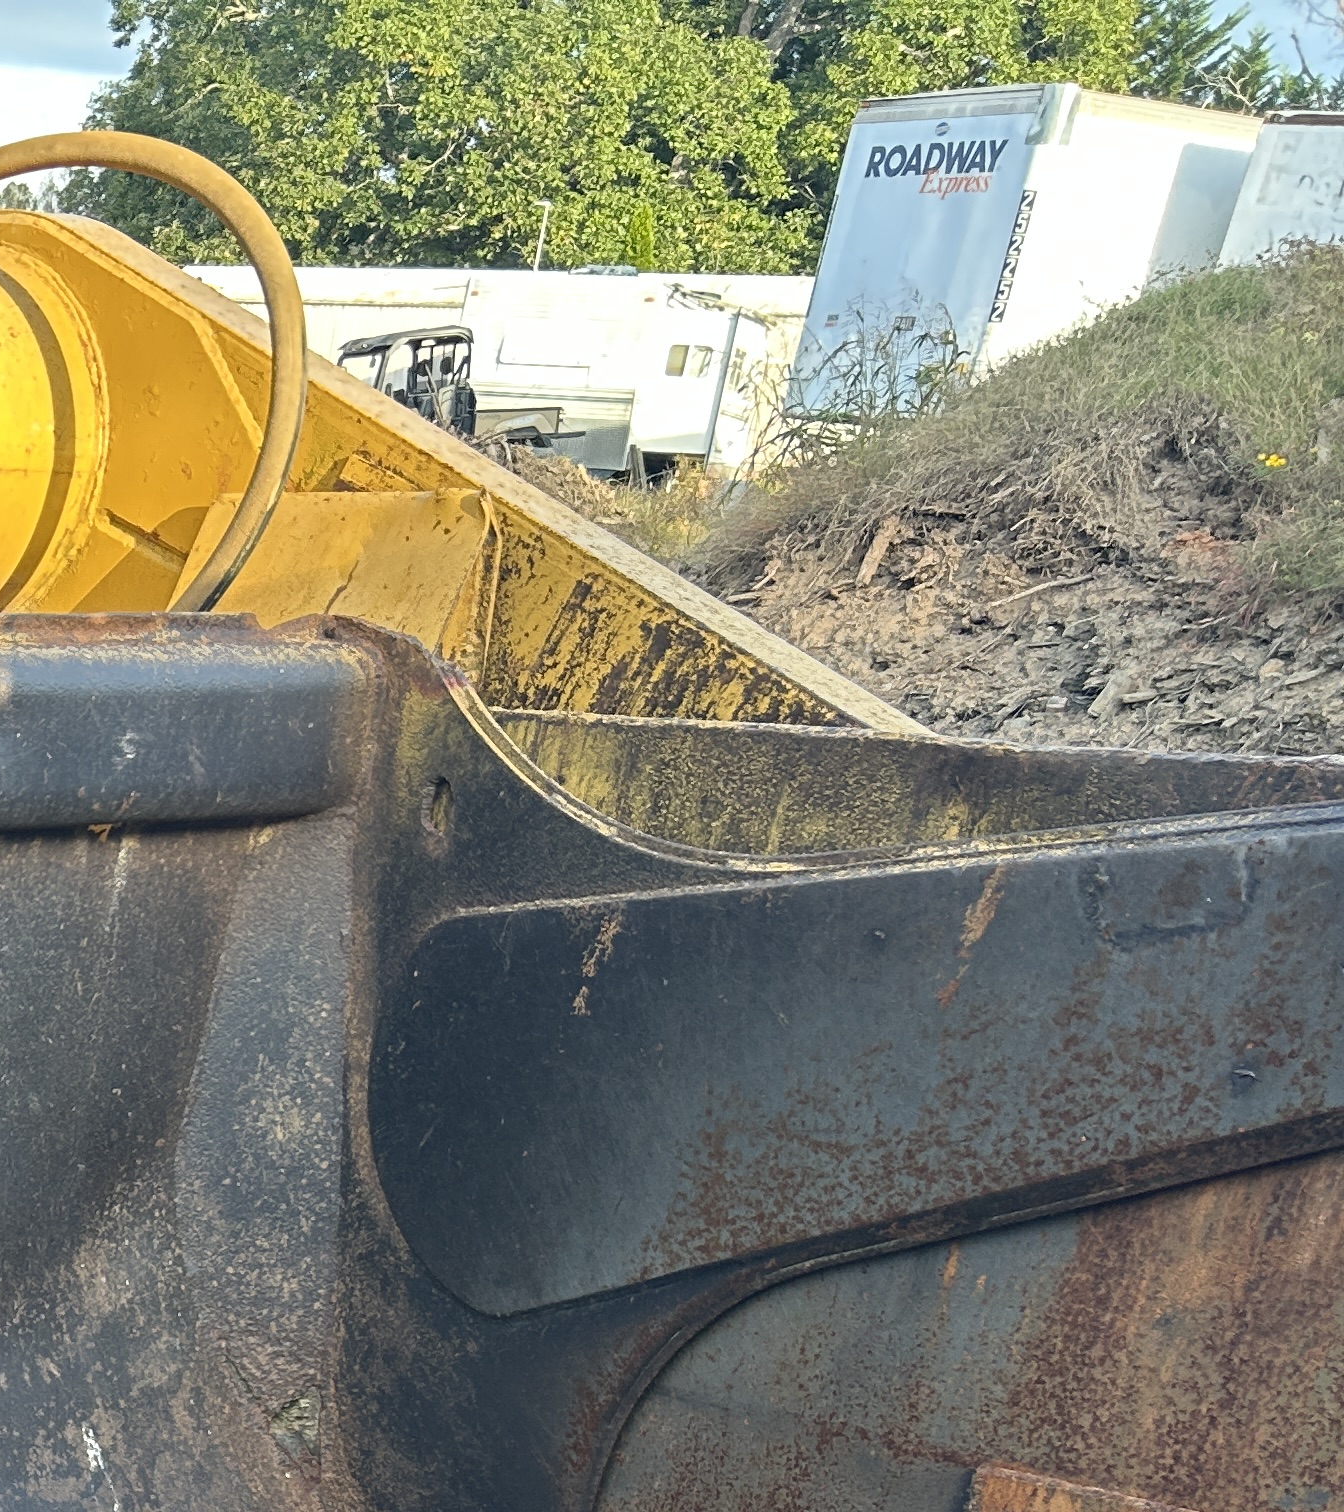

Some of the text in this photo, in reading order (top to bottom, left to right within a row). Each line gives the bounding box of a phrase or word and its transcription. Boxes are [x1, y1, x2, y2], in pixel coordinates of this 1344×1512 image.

[864, 139, 1009, 178] ROADWAY
[919, 168, 992, 200] Express
[990, 190, 1036, 322] 252252
